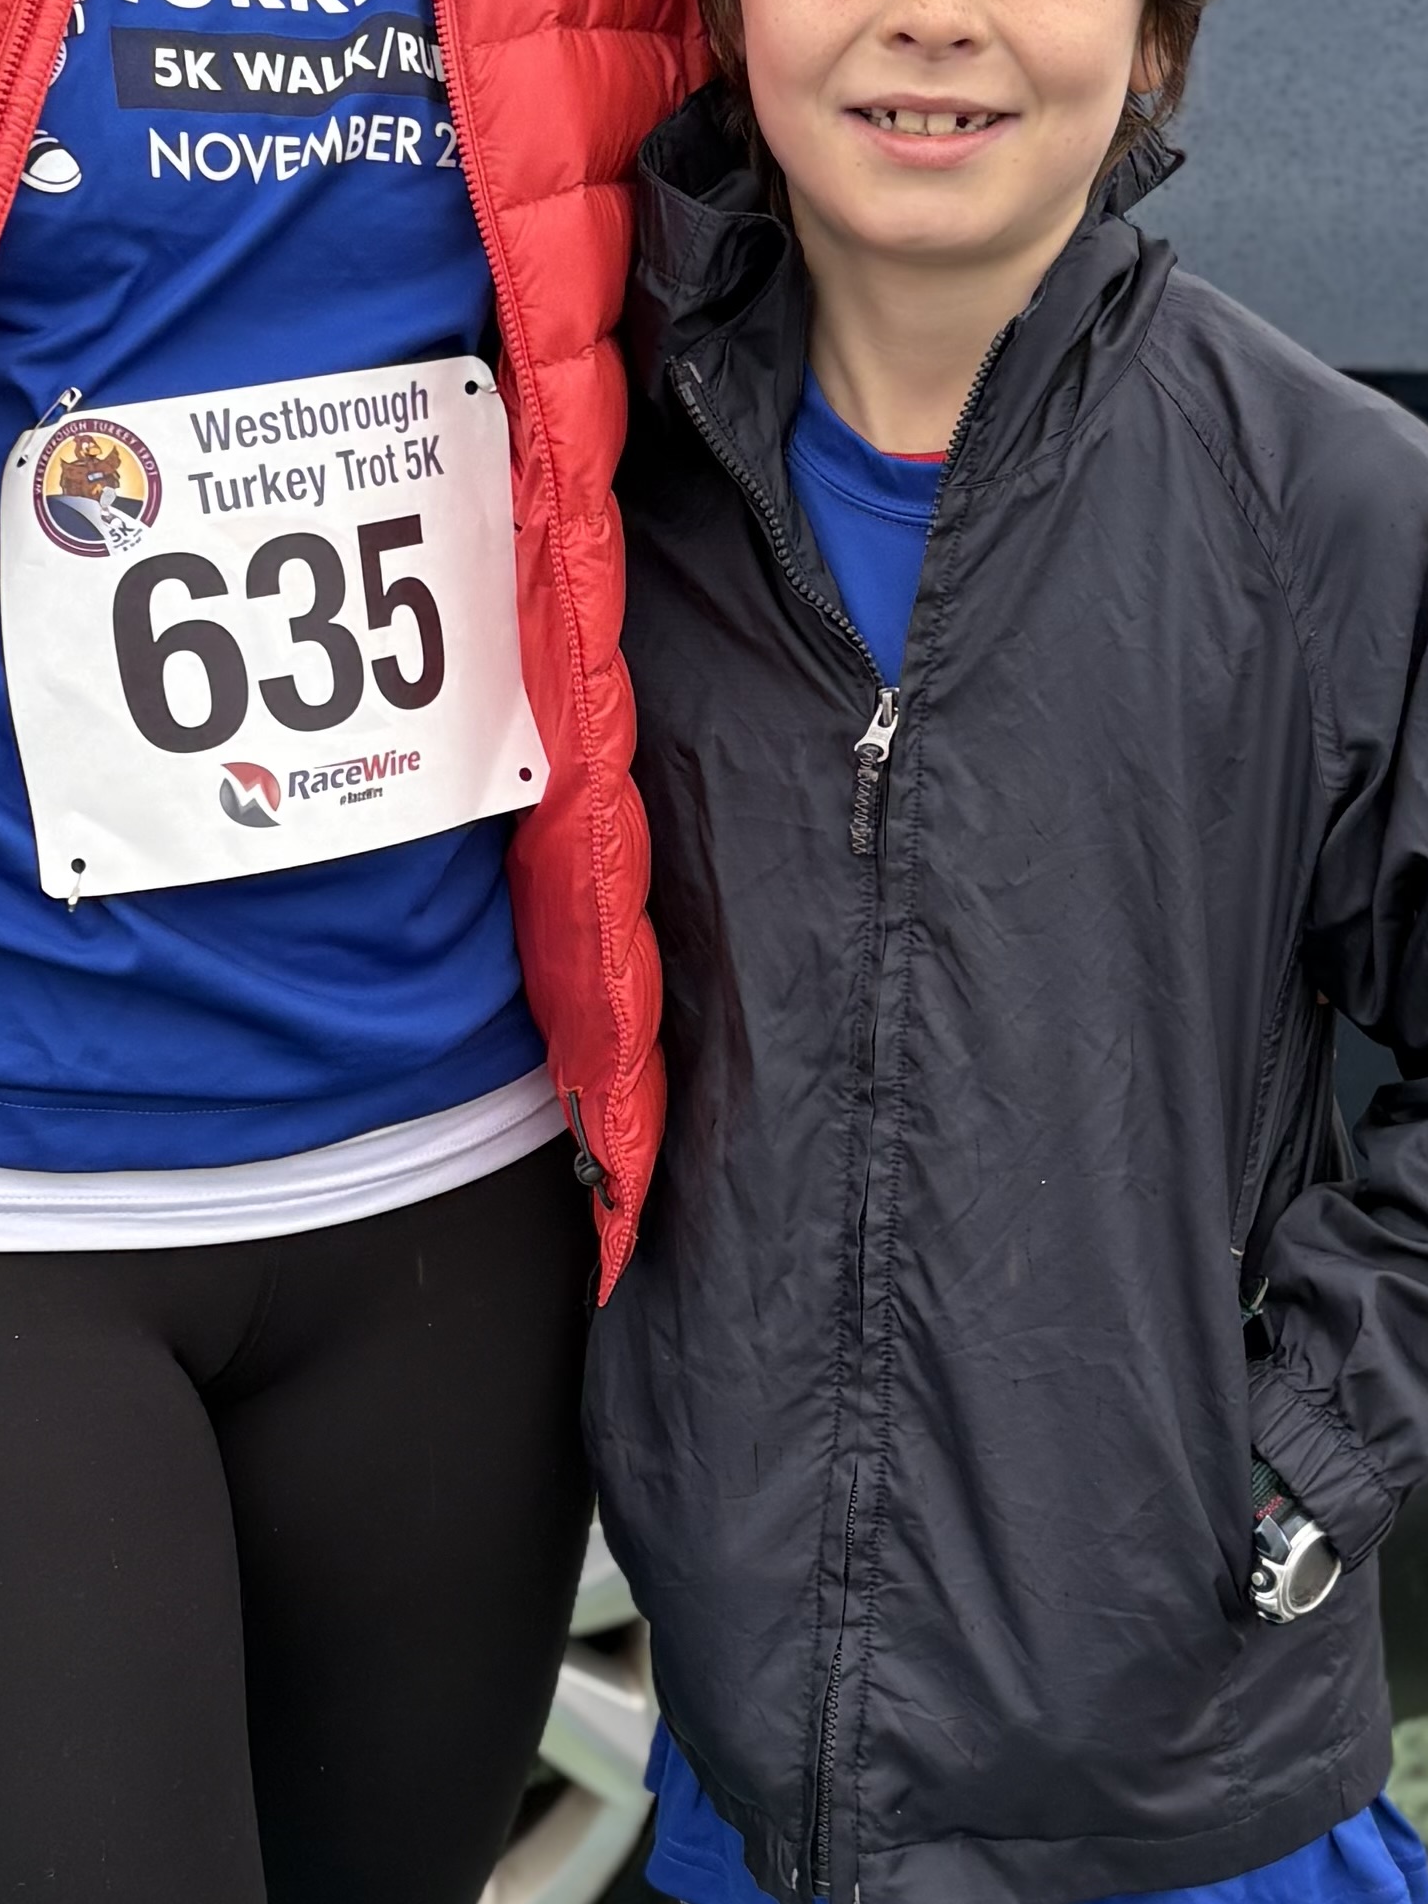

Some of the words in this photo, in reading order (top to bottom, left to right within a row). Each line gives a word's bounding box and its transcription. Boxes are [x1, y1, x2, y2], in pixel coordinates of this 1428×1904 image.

[153, 47, 222, 91] 5K
[149, 115, 422, 185] NOVEMBER
[189, 380, 429, 454] Westborough
[187, 463, 326, 515] Turkey
[335, 444, 400, 491] Trot
[404, 434, 445, 481] 5K
[111, 513, 446, 755] 635
[288, 749, 422, 800] RaceWire
